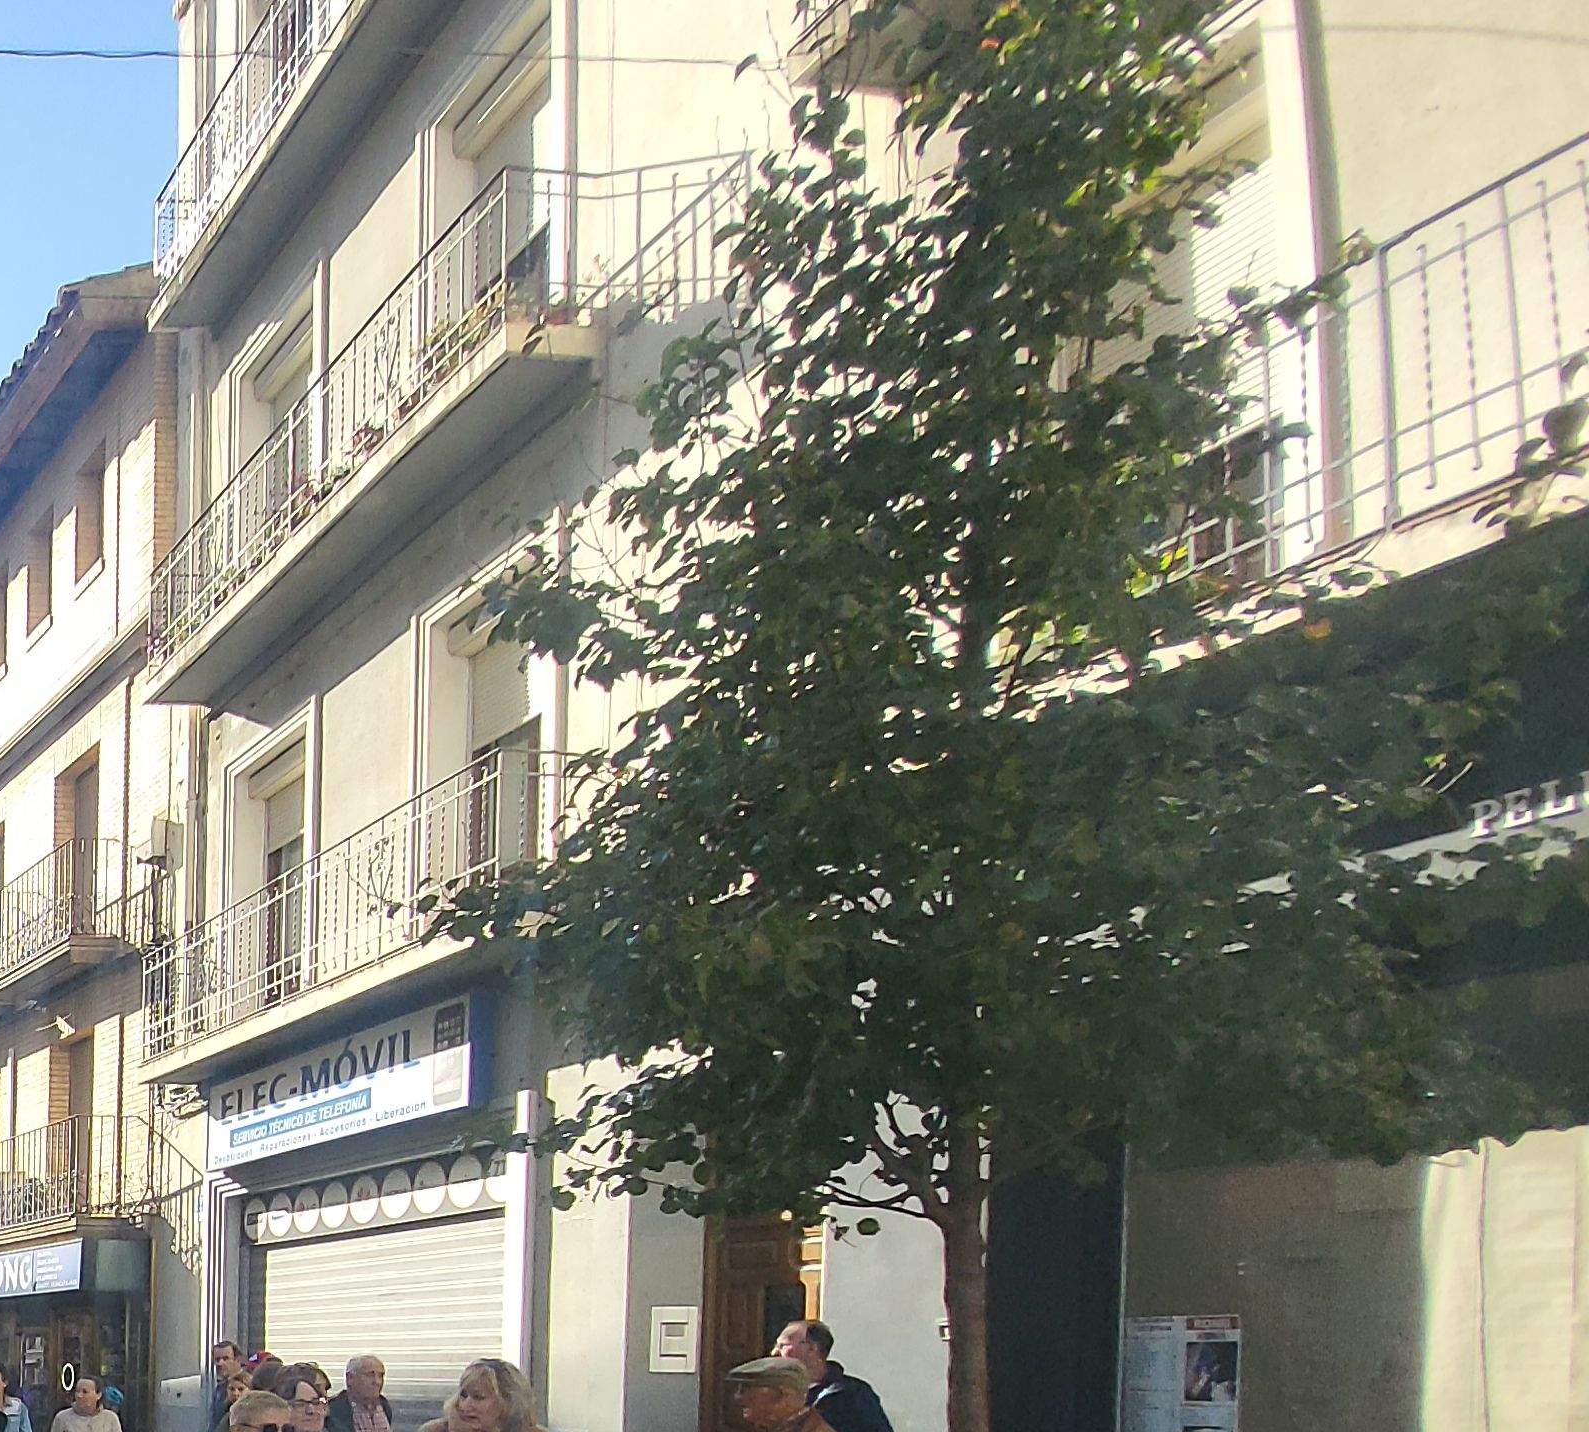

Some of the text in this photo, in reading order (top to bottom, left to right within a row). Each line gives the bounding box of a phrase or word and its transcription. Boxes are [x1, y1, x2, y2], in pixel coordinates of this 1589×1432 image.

[221, 1030, 420, 1125] ELEC-MÓVIL
[233, 1093, 368, 1145] SERVICIO TÉCNICO DE TELEFONÍA
[319, 1117, 366, 1137] Accesorios
